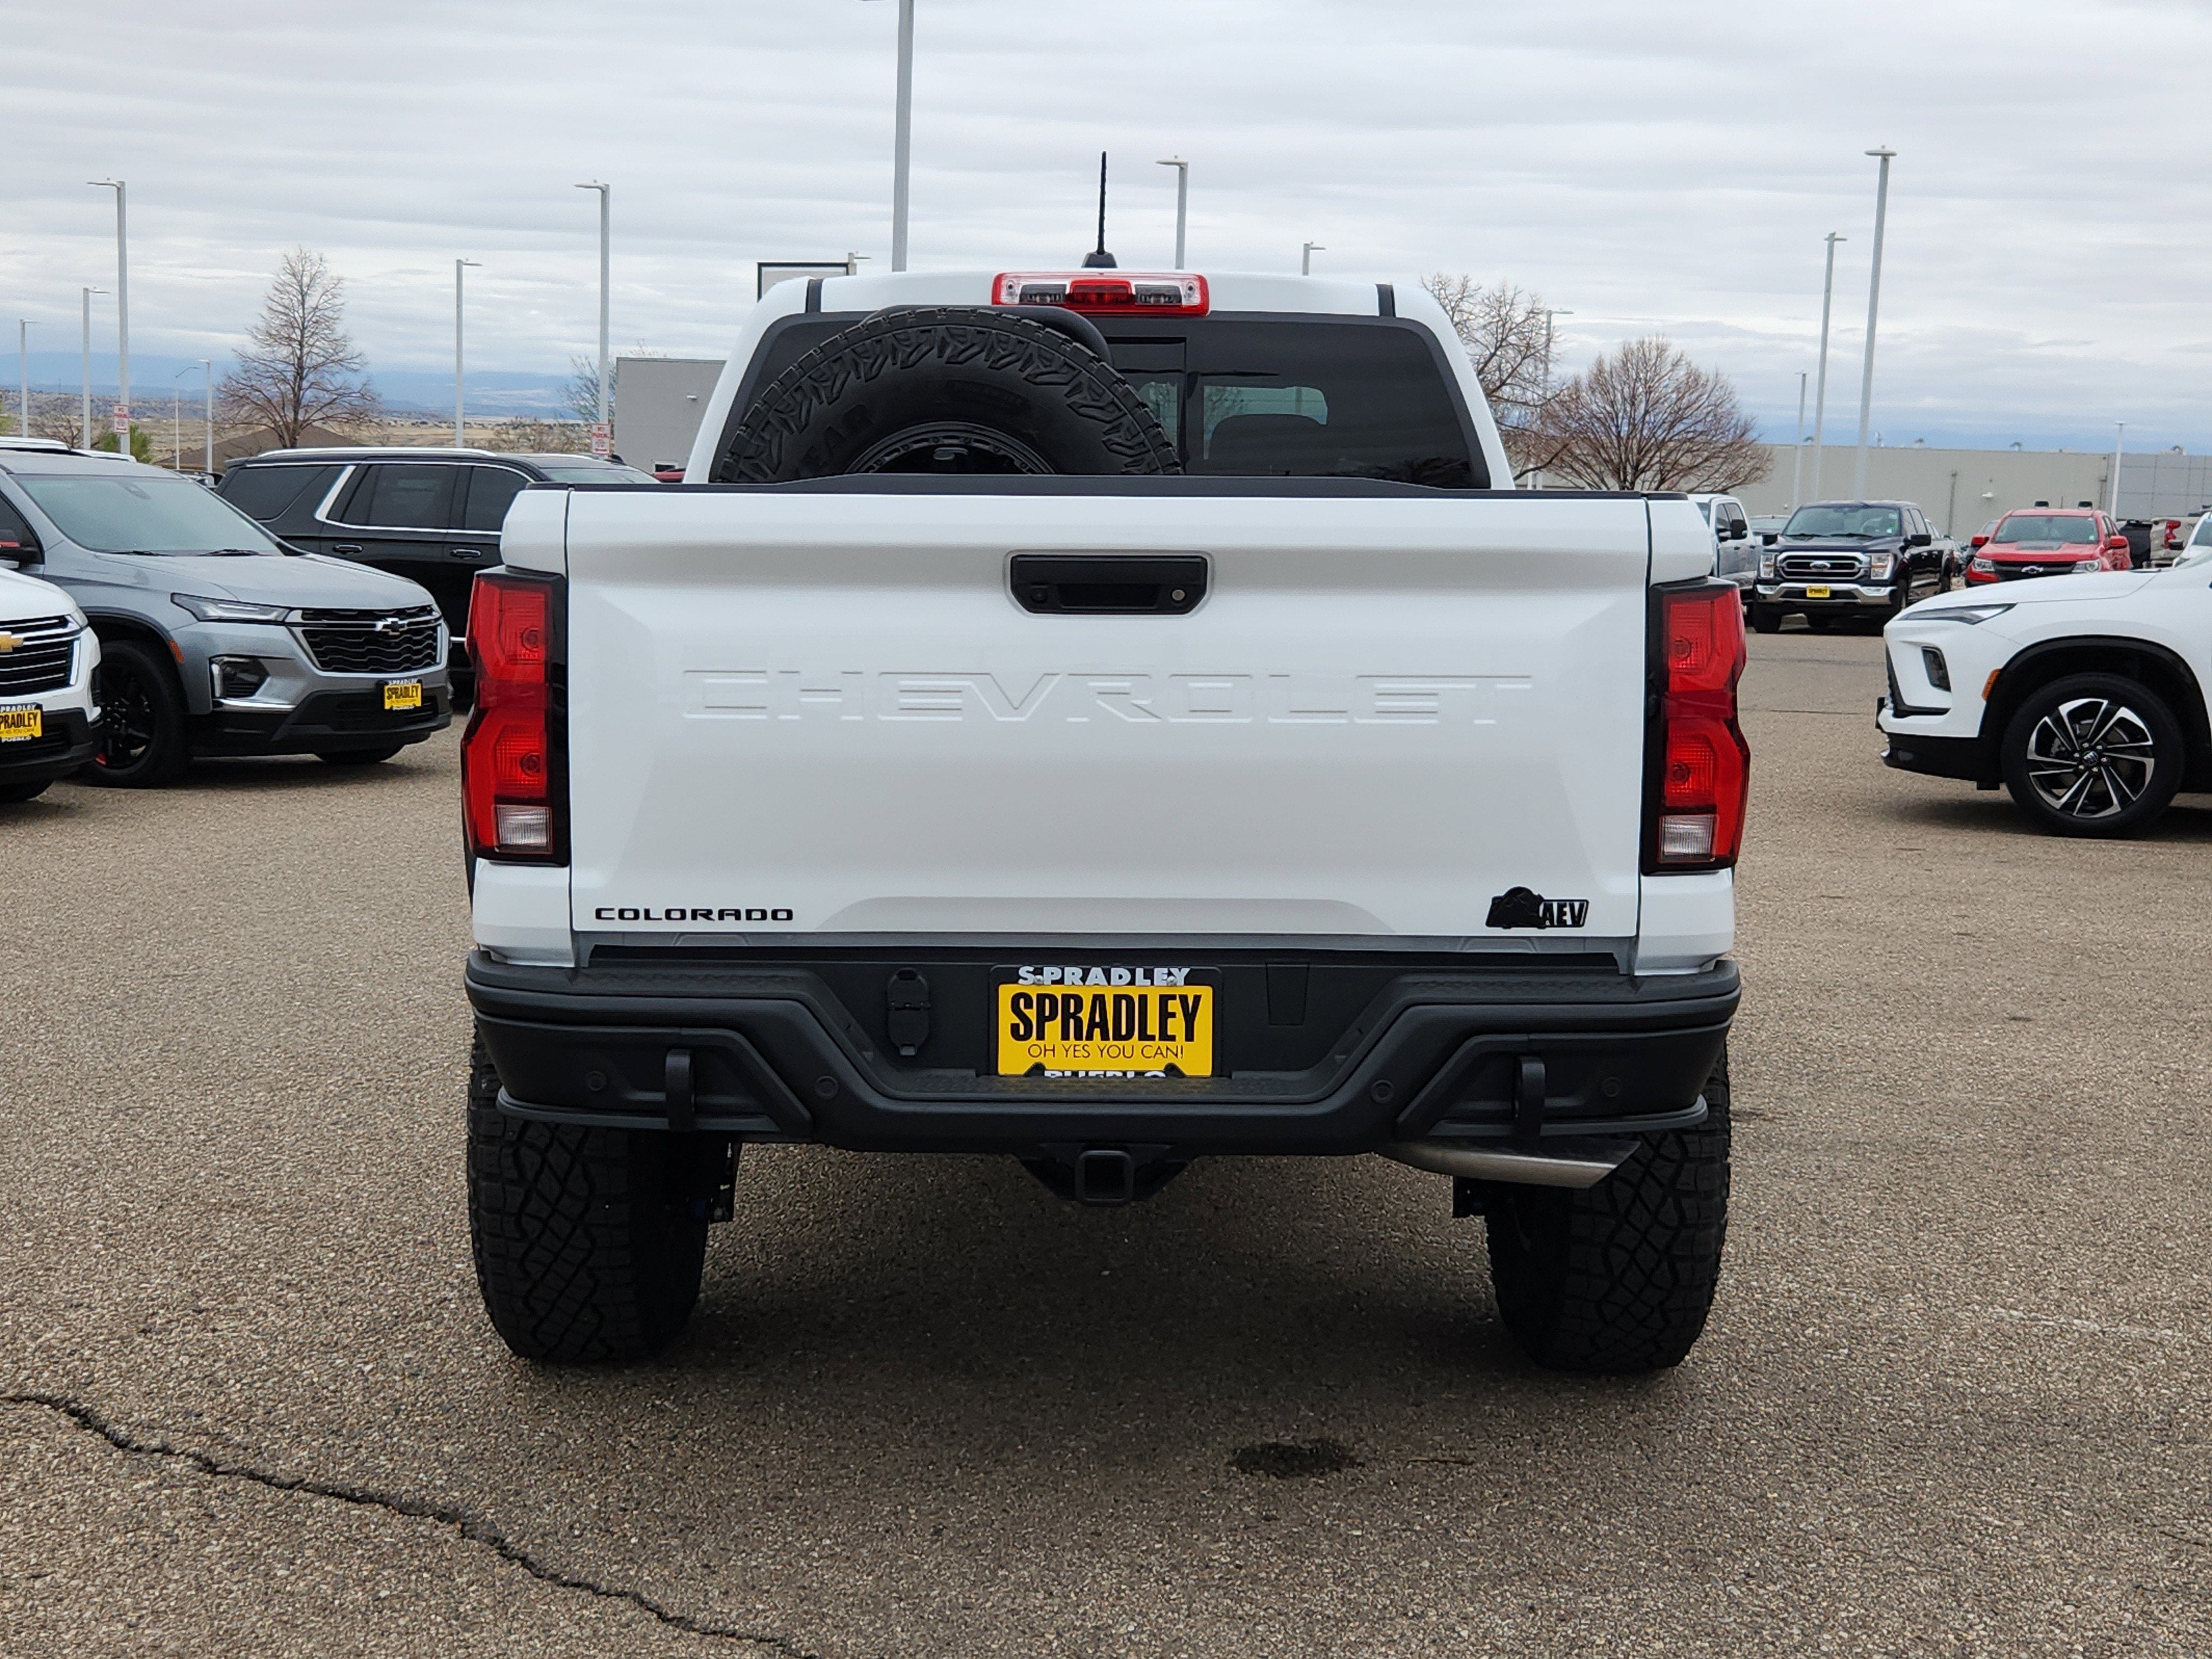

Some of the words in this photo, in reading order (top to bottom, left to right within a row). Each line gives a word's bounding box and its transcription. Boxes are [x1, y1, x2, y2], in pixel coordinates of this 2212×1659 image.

[684, 670, 1532, 724] CHEVROLET
[1, 705, 36, 713] PRADLEY
[0, 712, 38, 730] PRADLEY
[595, 907, 794, 921] COLORADO
[1542, 902, 1586, 925] AEV
[1017, 966, 1191, 986] SPRADLEY
[1010, 992, 1203, 1043] SPRADLEY
[1027, 1043, 1056, 1058] OH
[1061, 1044, 1091, 1058] YES
[1096, 1044, 1135, 1059] YOU
[1141, 1044, 1184, 1059] CAN!
